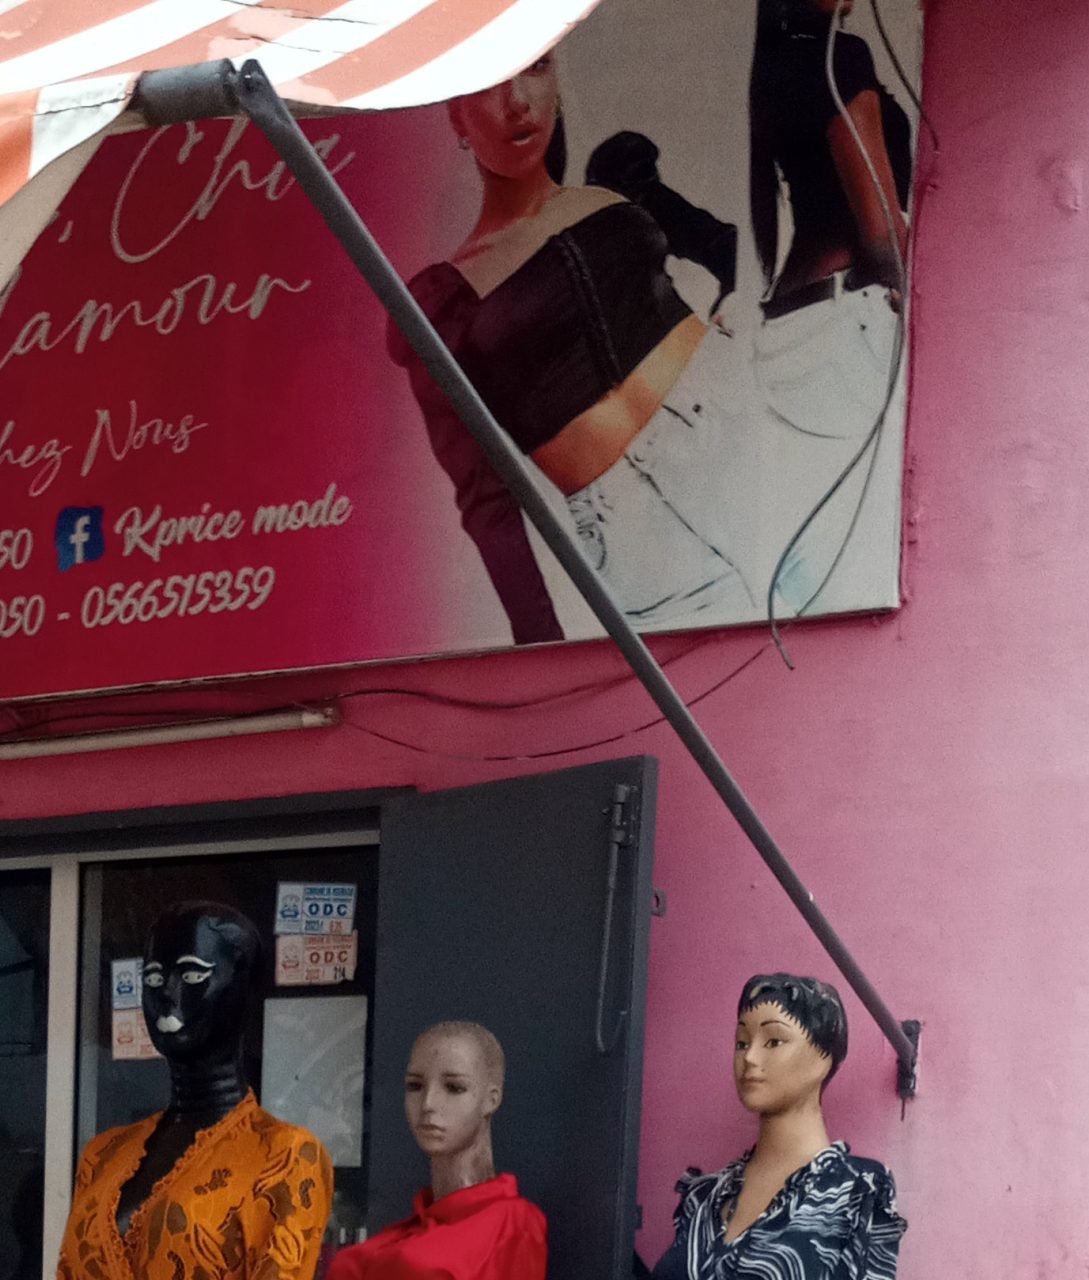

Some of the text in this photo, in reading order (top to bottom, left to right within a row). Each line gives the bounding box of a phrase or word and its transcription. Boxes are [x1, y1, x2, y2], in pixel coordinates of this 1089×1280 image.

[80, 399, 208, 477] Nous
[113, 481, 355, 563] Kprice mode
[80, 565, 276, 629] 0566515359
[308, 903, 348, 917] ODC
[309, 950, 349, 964] ODC
